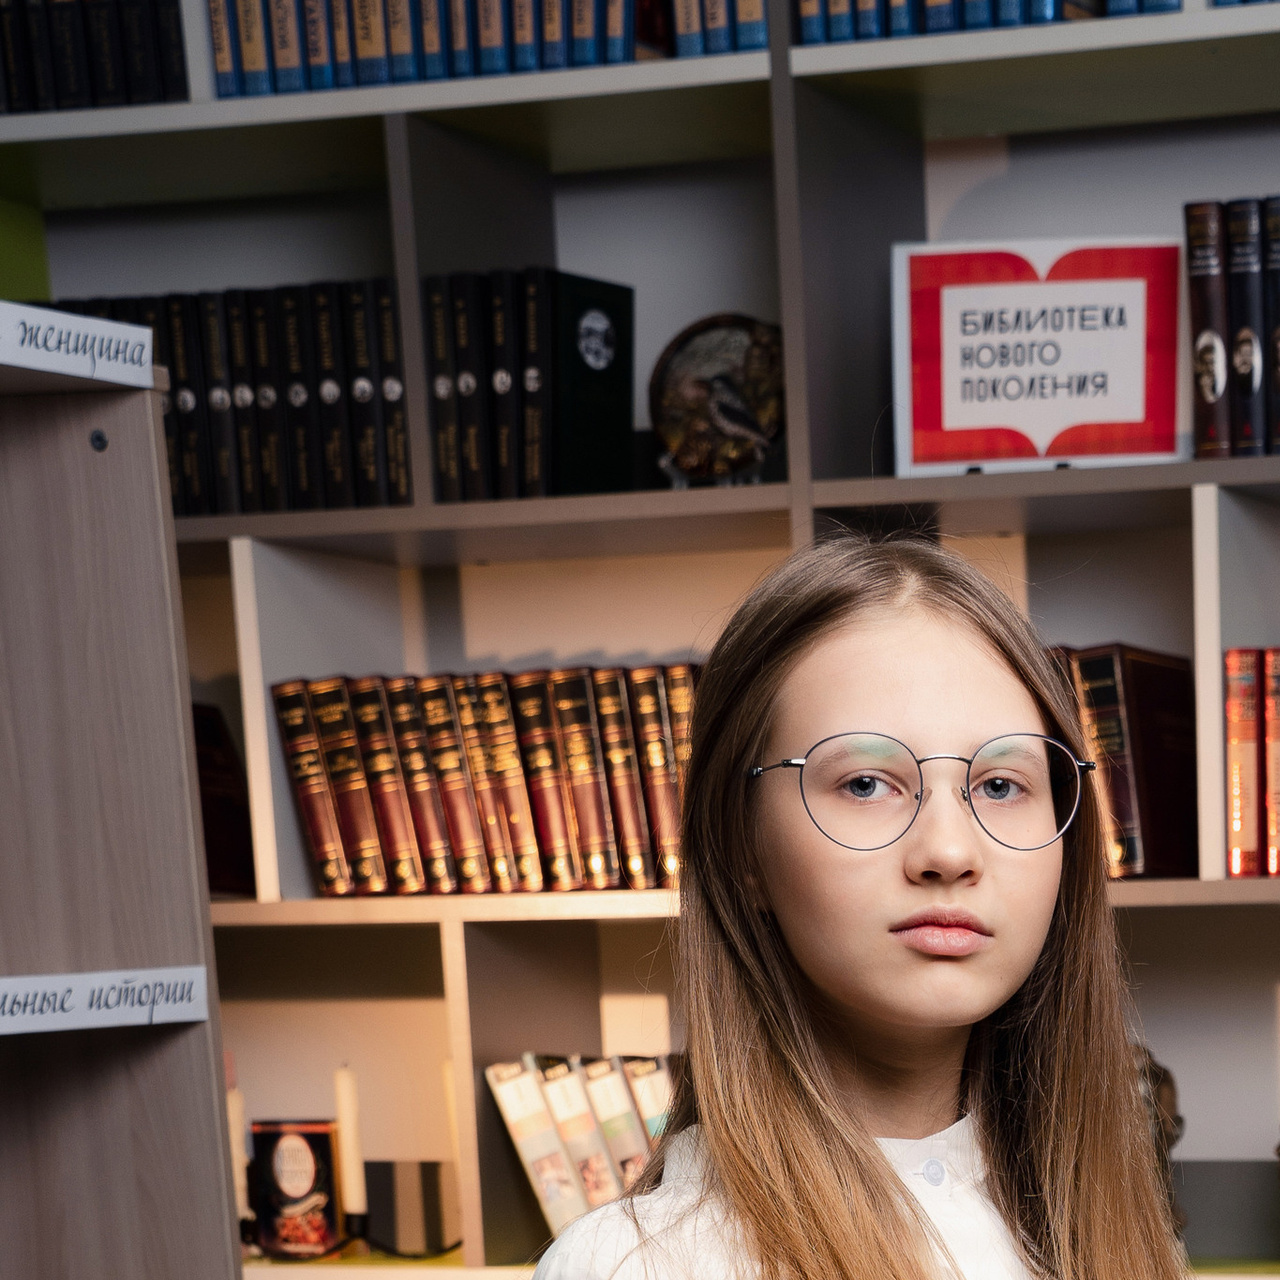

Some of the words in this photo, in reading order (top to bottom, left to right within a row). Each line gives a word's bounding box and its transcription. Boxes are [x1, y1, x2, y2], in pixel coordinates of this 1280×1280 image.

[960, 304, 1128, 336] БИБЛИОТЕКА
[18, 319, 148, 378] женщина
[960, 339, 1062, 370] НОВОГО
[960, 370, 1109, 403] ПОКОЛЕНИЯ
[88, 977, 195, 1025] истории
